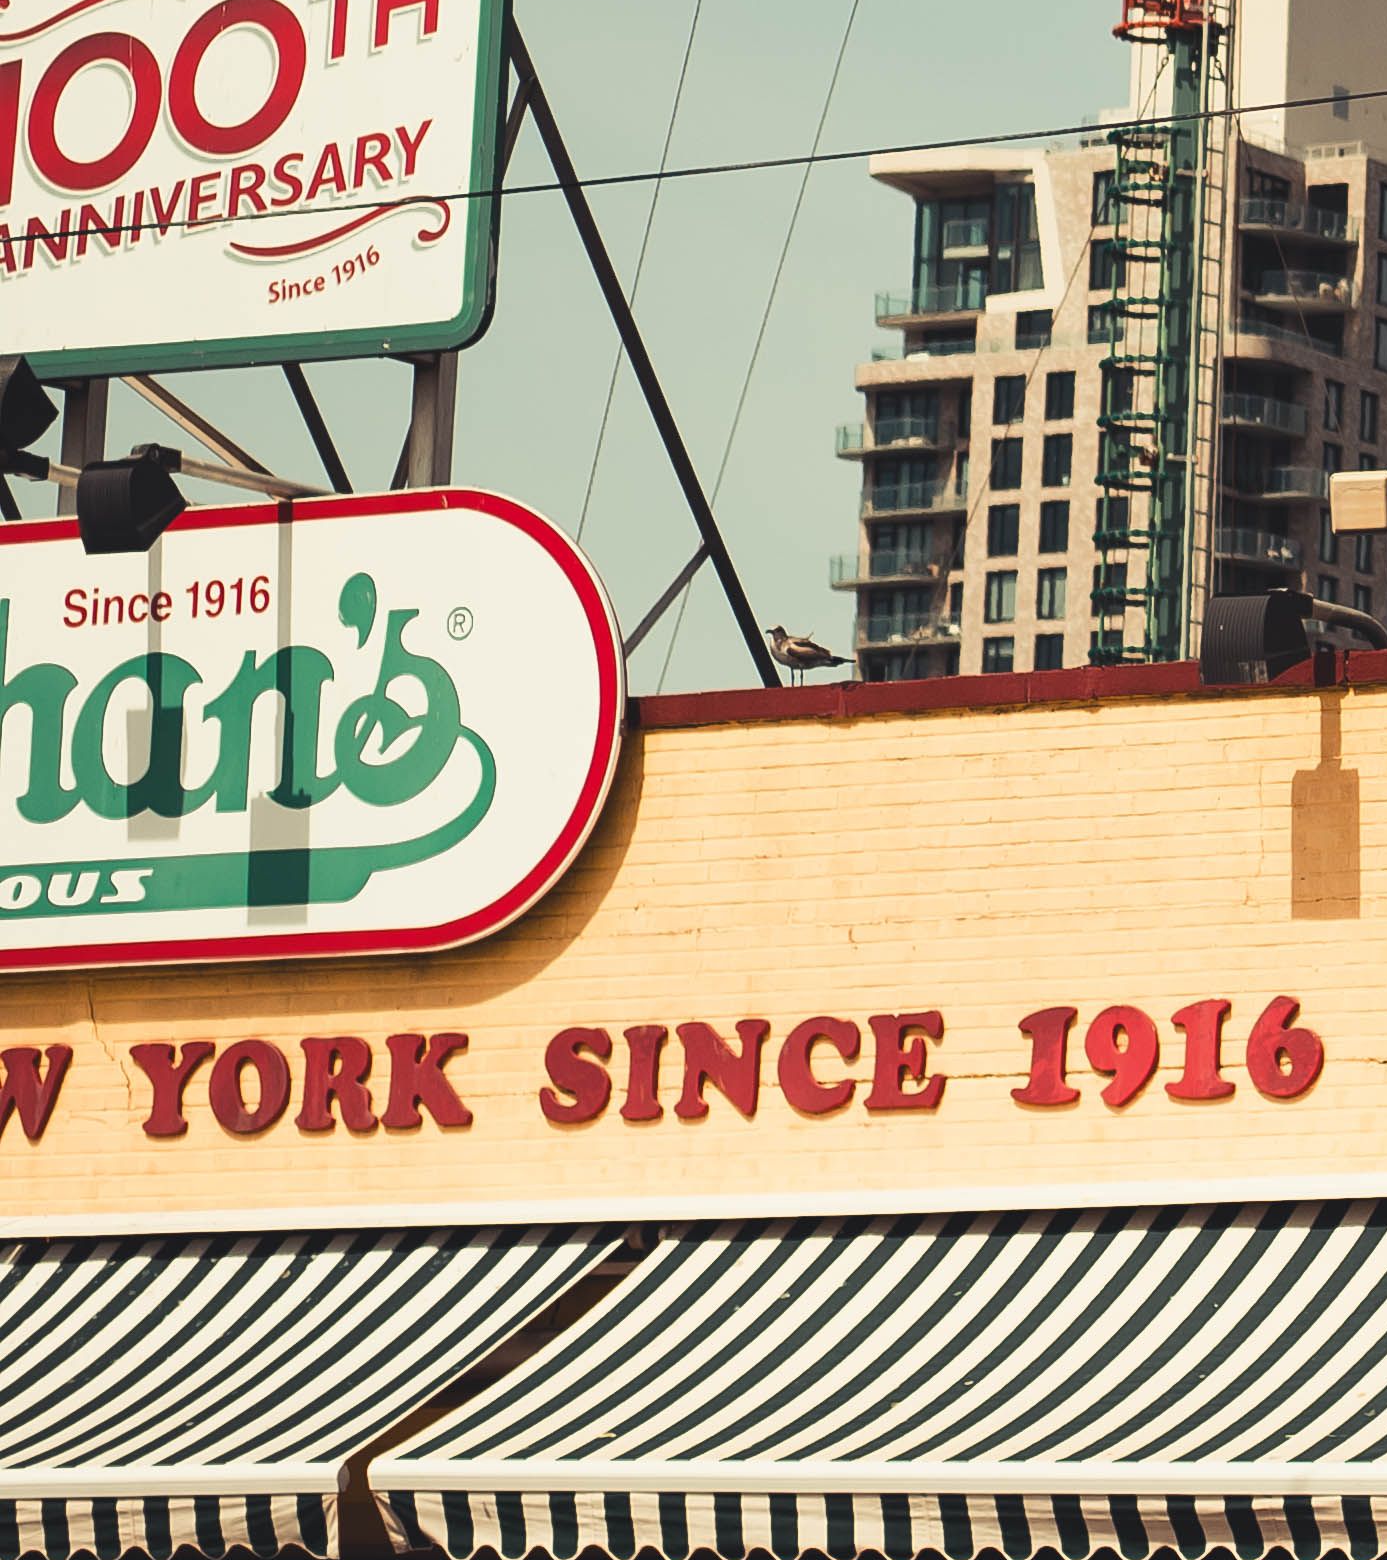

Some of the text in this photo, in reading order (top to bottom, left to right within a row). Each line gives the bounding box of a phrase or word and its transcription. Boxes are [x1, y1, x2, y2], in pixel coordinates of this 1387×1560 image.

[267, 245, 382, 305] Since 1916
[63, 574, 272, 630] Since 1916
[128, 1030, 474, 1140] YORK
[538, 1010, 948, 1126] SINCE
[1010, 994, 1326, 1109] 1916
